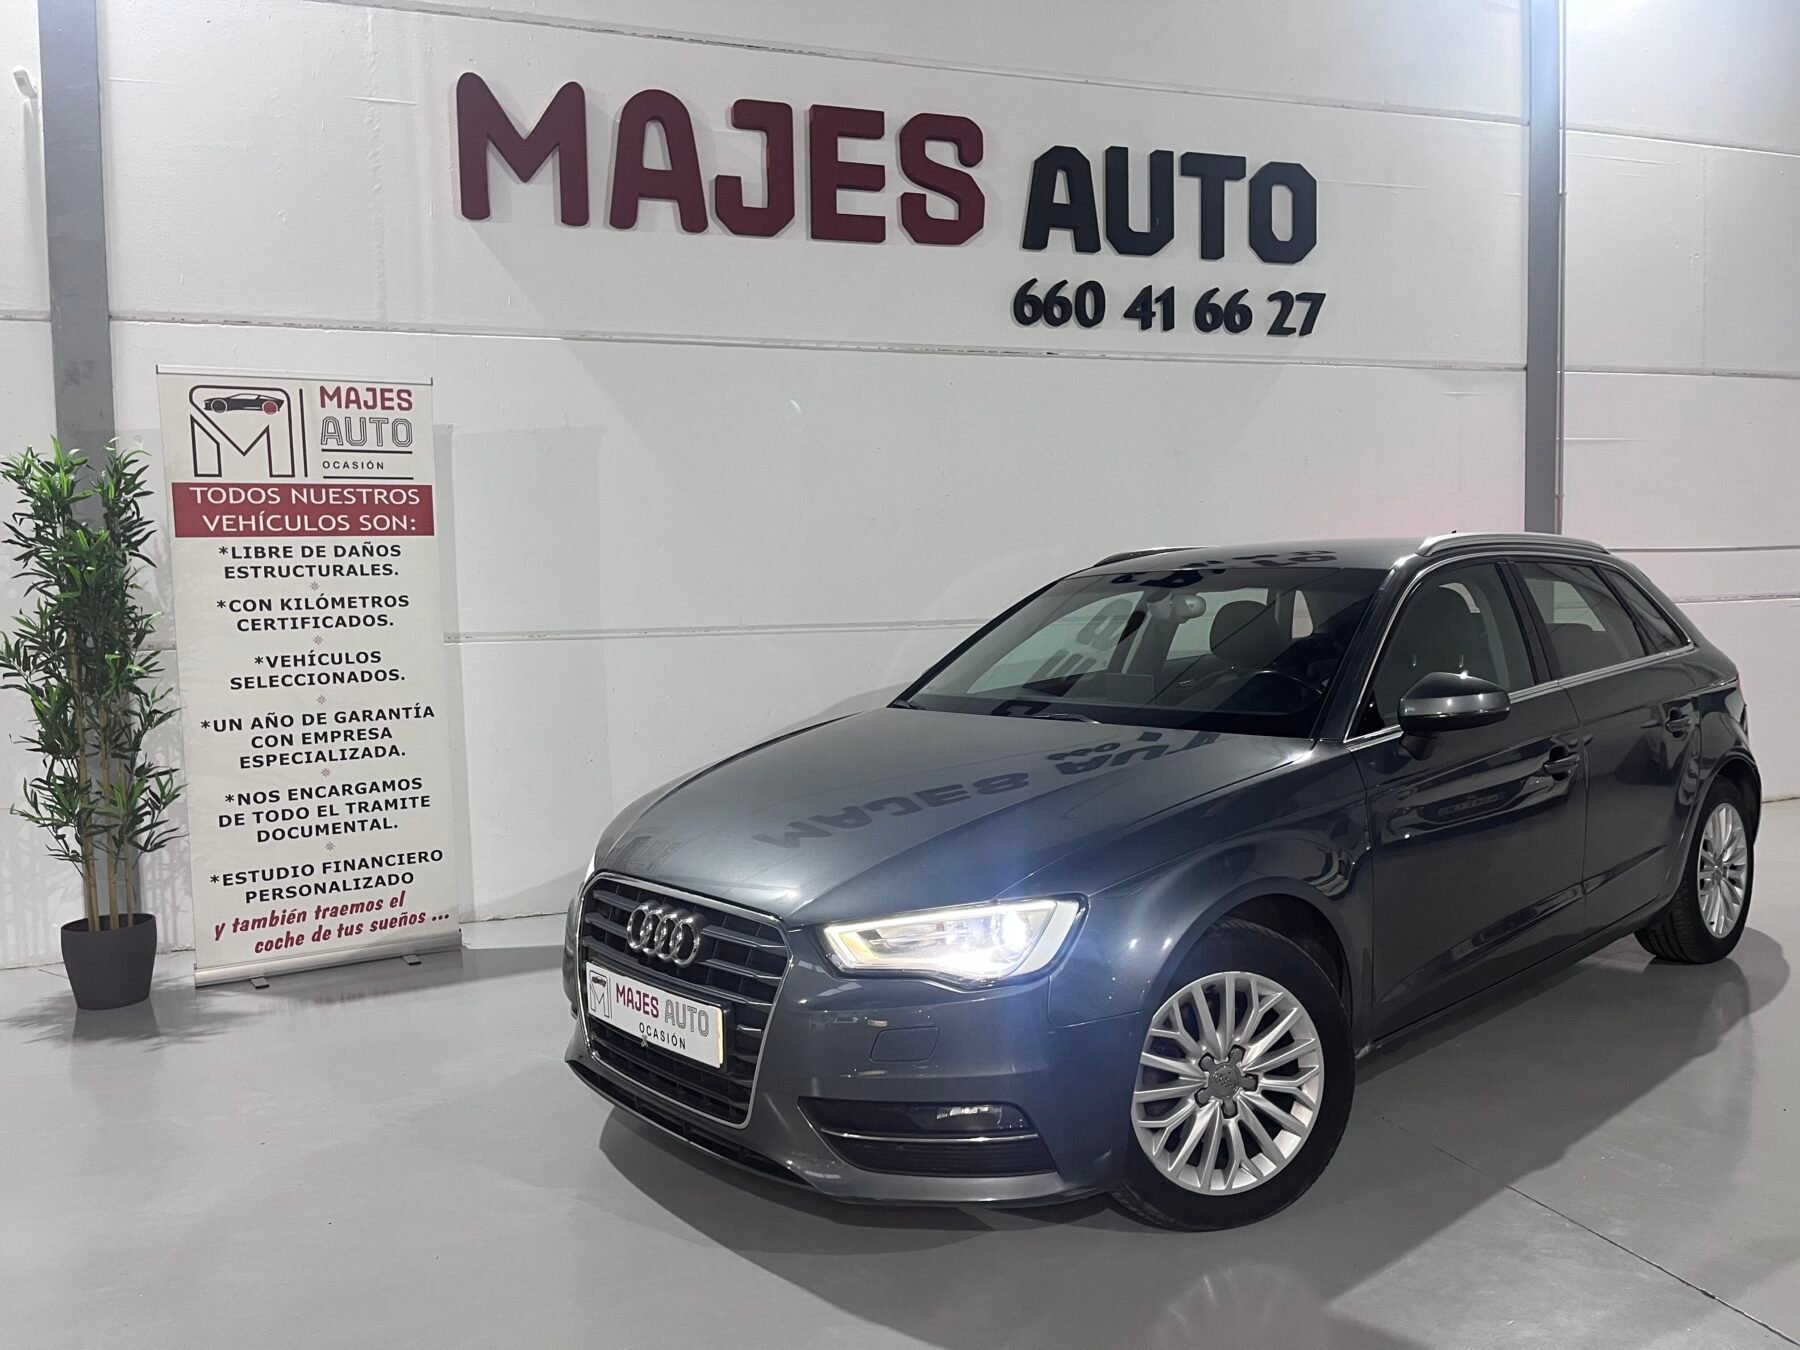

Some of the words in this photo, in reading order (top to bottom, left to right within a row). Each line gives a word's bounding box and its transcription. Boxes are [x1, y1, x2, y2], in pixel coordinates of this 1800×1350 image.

[457, 73, 985, 246] MAJES
[1022, 146, 1316, 264] AUTO
[1013, 278, 1105, 328] 660
[1123, 285, 1174, 331] 41
[1194, 288, 1252, 334] 66
[1267, 291, 1326, 336] 27
[320, 386, 412, 411] MAJES
[321, 416, 412, 447] AUTO
[323, 458, 383, 469] OCASIÓN
[190, 488, 280, 504] TODOS
[292, 488, 419, 504] NUESTROS
[203, 511, 349, 531] VEHÍCULOS
[360, 515, 415, 530] SON:
[301, 546, 326, 557] DE
[334, 542, 401, 557] DAÑOS
[225, 564, 398, 578] ESTRUCTURALES.
[281, 595, 409, 610] KILÓMETROS
[237, 614, 393, 631] CERTIFICADOS.
[231, 669, 404, 689] SELECCIONADOS.
[251, 712, 293, 729] AÑO
[302, 713, 326, 726] DE
[335, 703, 434, 723] GARANTÍA
[252, 734, 293, 748] CON
[302, 727, 392, 744] EMPRESA
[240, 745, 405, 768] ESPECIALIZADA.
[288, 778, 422, 801] ENCARGAMOS
[219, 813, 245, 827] DE
[252, 807, 309, 823] TODO
[318, 805, 339, 817] EL
[345, 796, 430, 814] TRAMITE
[258, 818, 397, 842] DOCUMENTAL.
[323, 850, 442, 874] FINANCIERO
[246, 872, 413, 903] PERSONALIZADO
[215, 923, 225, 941] y
[233, 909, 307, 933] también
[315, 899, 383, 920] traemos
[390, 891, 405, 908] el
[255, 931, 304, 953] coche
[312, 925, 331, 942] de
[337, 924, 363, 938] tus
[370, 912, 425, 932] sueños
[616, 983, 659, 1018] MAJES
[665, 999, 709, 1037] AUTO
[639, 1023, 685, 1049] OCASIÓN
